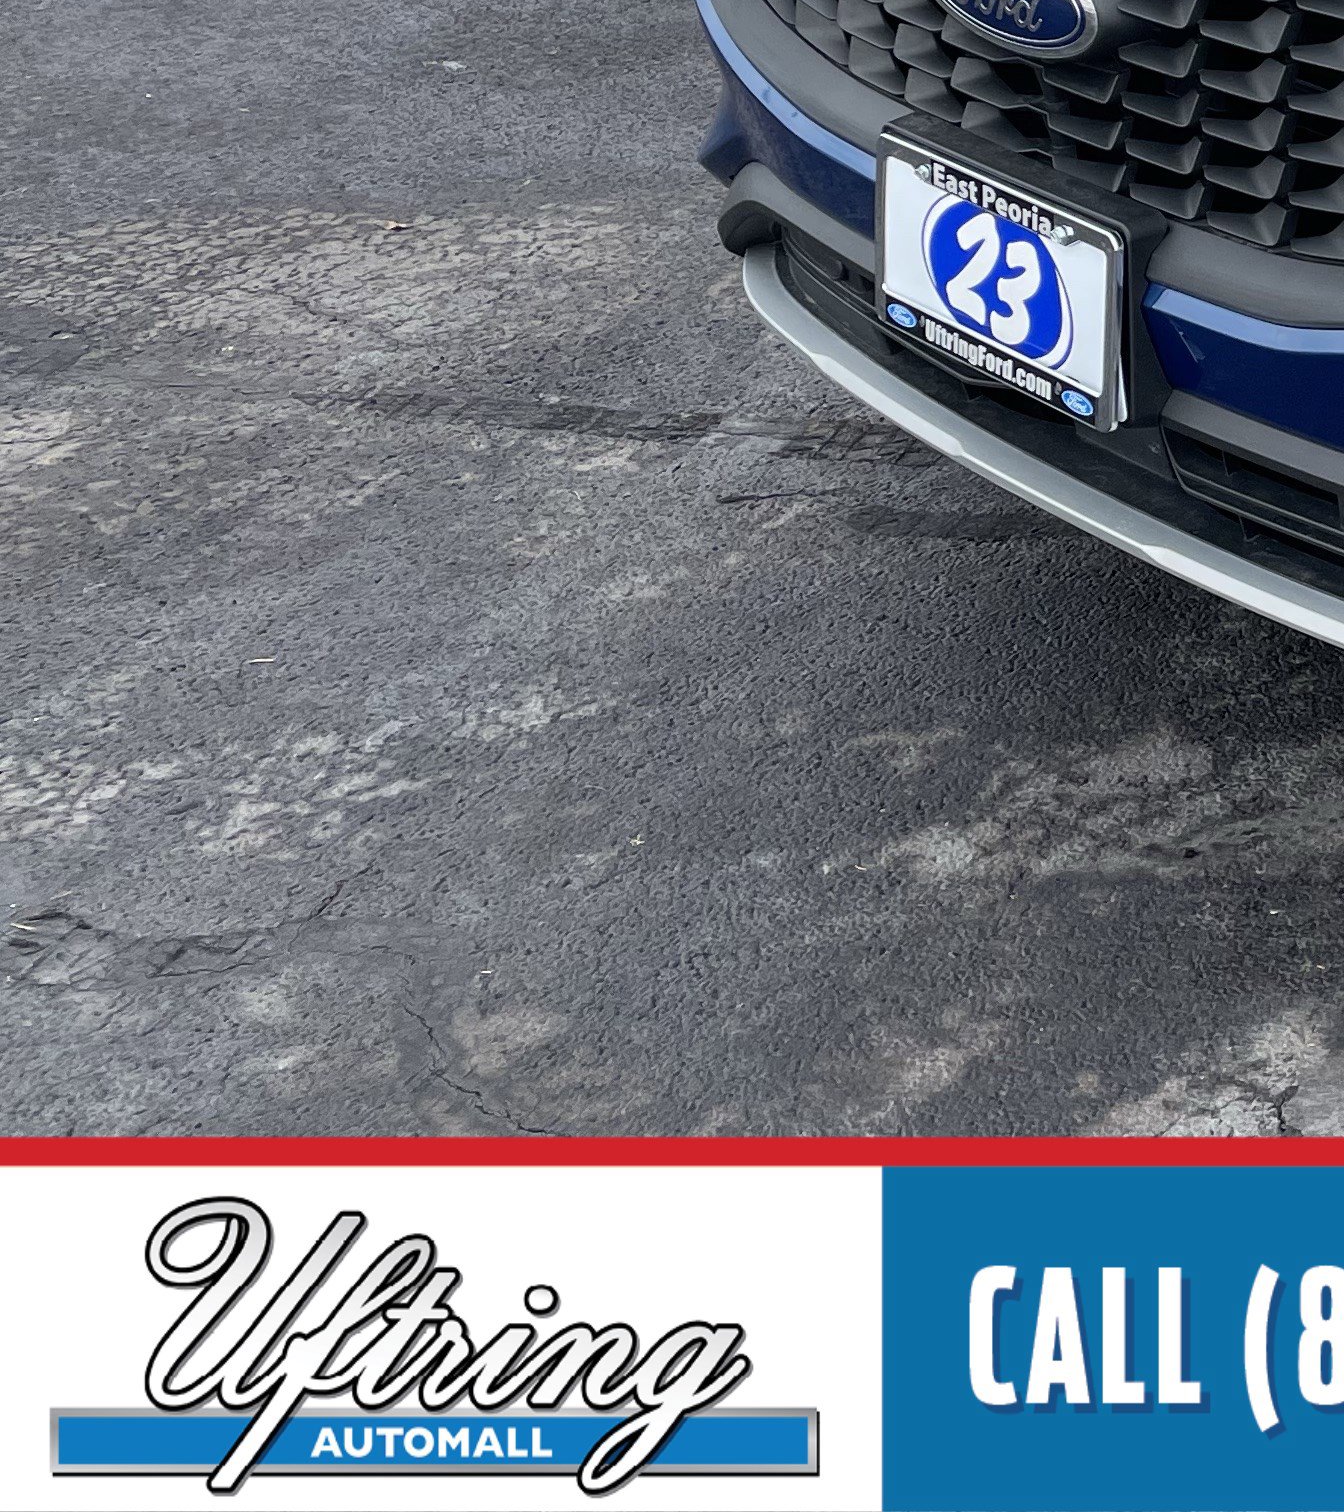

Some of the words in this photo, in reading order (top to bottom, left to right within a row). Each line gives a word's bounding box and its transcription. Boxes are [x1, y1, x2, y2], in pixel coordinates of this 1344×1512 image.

[932, 161, 978, 204] East
[981, 188, 1052, 237] Peoria
[945, 212, 1042, 345] 23
[925, 318, 1052, 401] UftringFord.com
